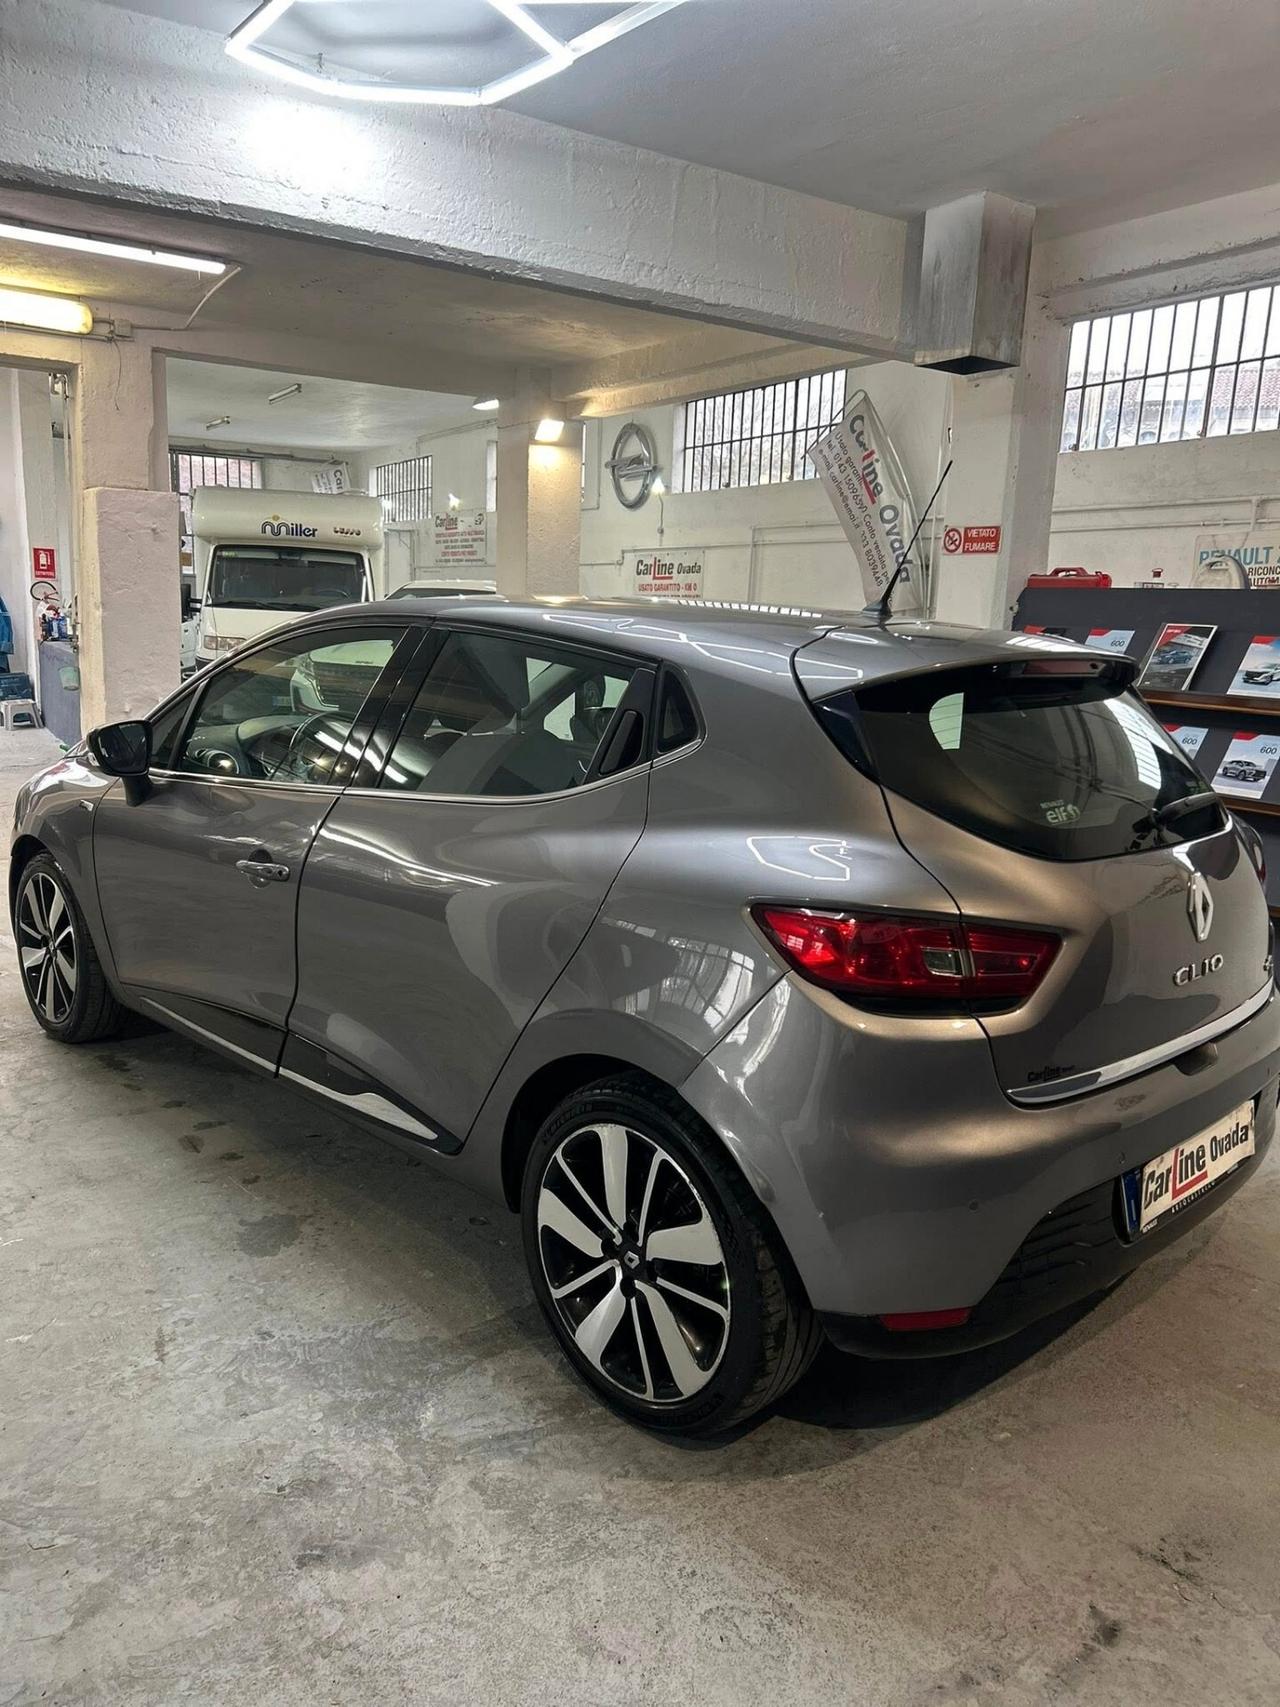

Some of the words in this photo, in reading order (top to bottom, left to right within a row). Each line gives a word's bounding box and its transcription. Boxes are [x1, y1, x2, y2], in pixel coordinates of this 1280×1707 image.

[967, 528, 997, 538] VIETATO
[880, 504, 913, 583] Ovada
[964, 542, 997, 552] FUMARE
[677, 562, 702, 575] Ovada
[638, 583, 653, 592] USATO
[654, 582, 681, 592] GARANTITO
[684, 582, 692, 591] KM
[1181, 737, 1198, 745] 600
[1259, 746, 1278, 755] 600
[1173, 952, 1224, 986] CLIO
[1143, 1147, 1208, 1210] CarLine
[1209, 1121, 1249, 1162] Ovada
